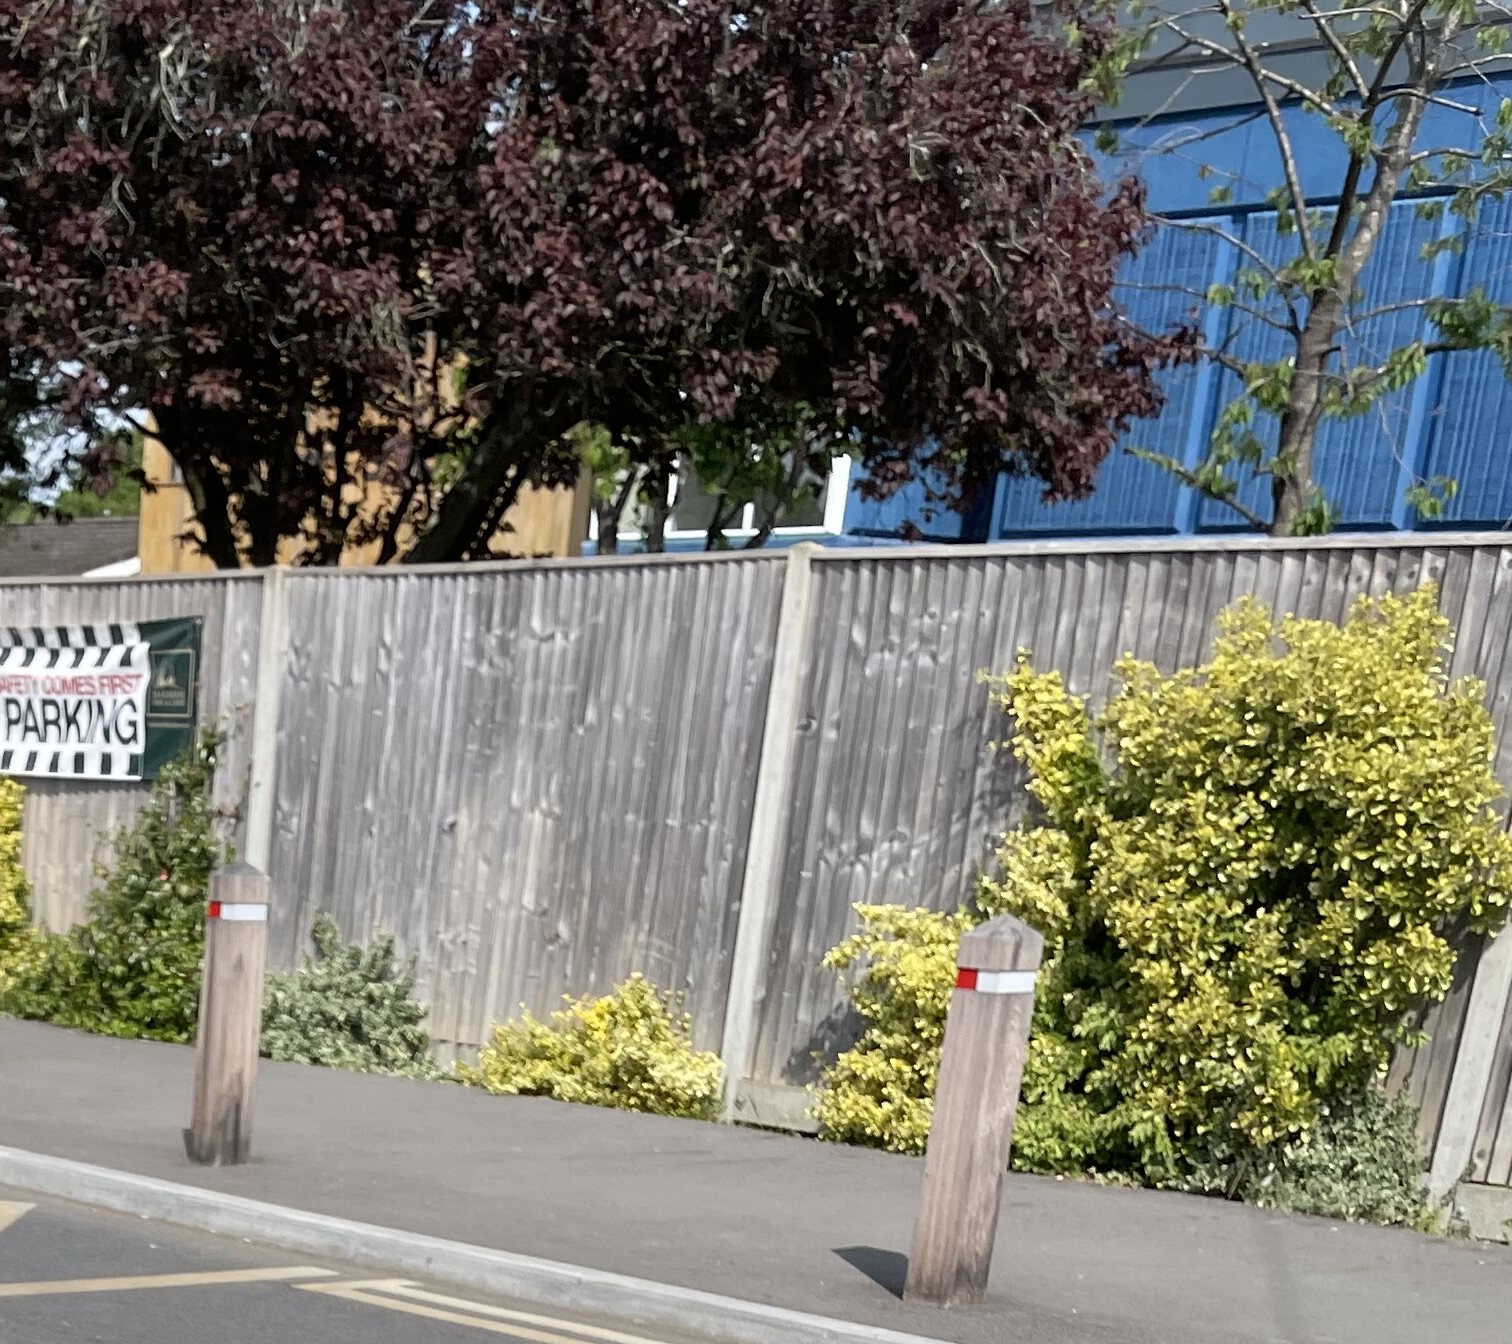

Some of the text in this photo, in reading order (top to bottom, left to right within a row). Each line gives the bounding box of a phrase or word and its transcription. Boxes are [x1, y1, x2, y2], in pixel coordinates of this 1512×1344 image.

[41, 675, 96, 695] COMES
[99, 674, 141, 695] FIRST
[4, 697, 138, 745] PARKING
